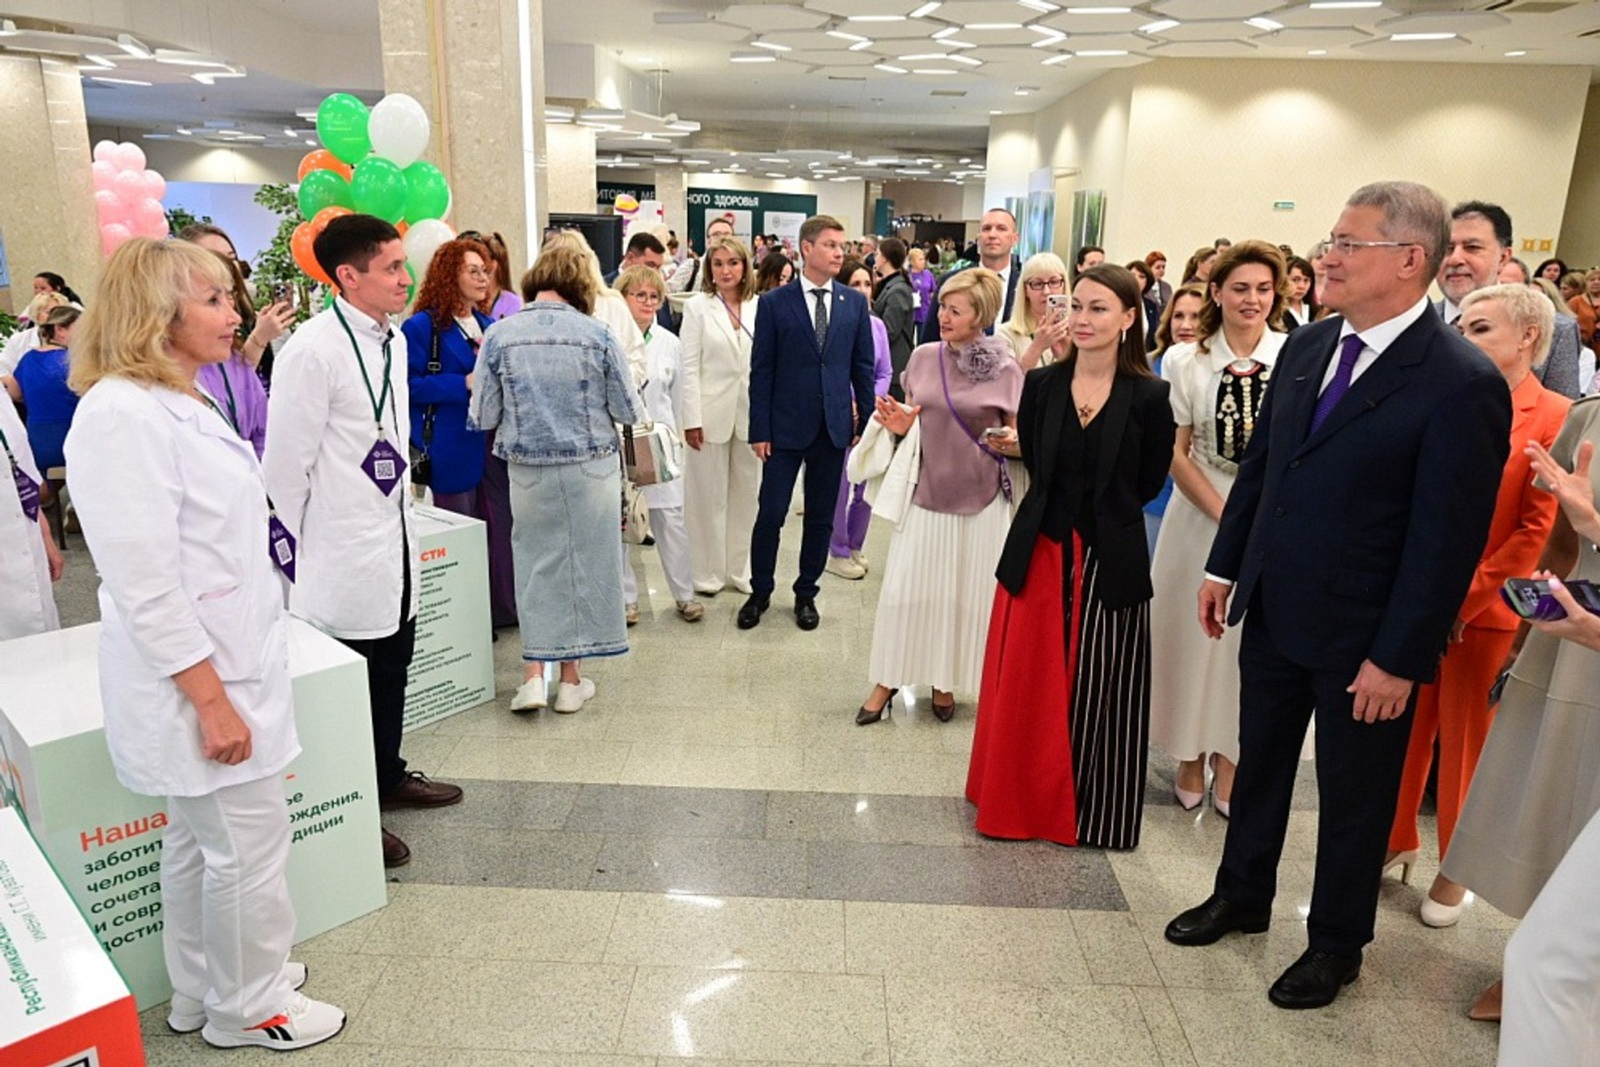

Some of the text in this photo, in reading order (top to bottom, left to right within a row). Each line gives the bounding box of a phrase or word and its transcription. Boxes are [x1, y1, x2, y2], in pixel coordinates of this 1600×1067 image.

[714, 195, 759, 208] ЗДОРОВЬЯ
[80, 812, 168, 852] Наша
[87, 861, 161, 893] челове
[91, 814, 345, 914] сочета диции
[94, 902, 162, 935] и совр
